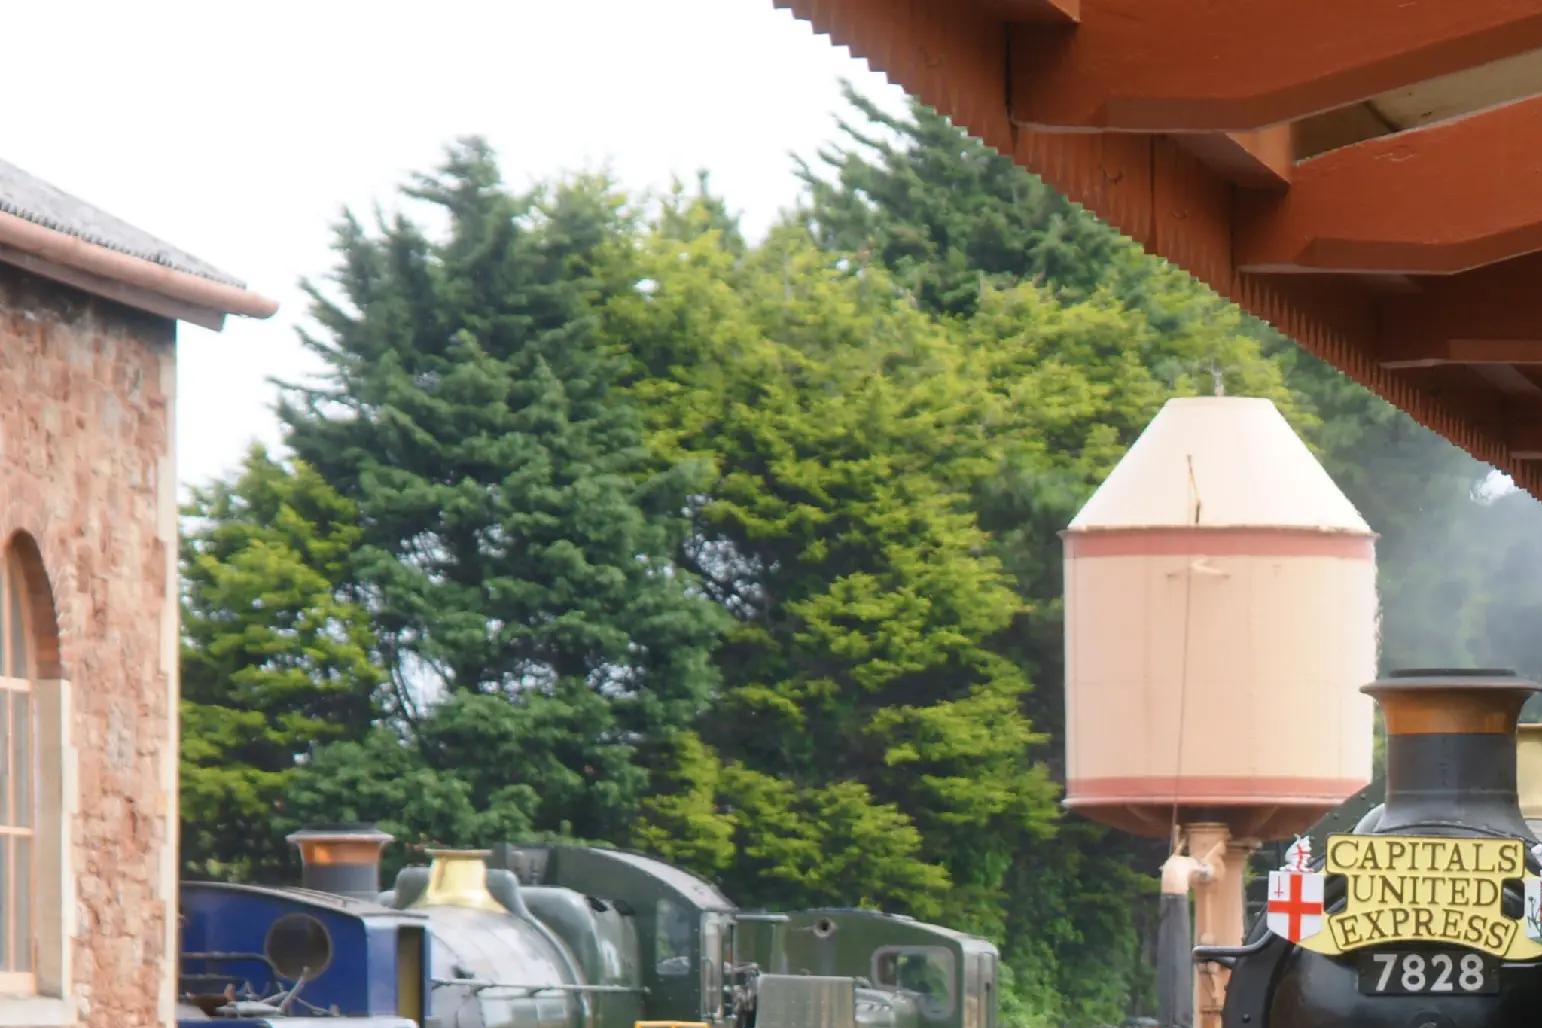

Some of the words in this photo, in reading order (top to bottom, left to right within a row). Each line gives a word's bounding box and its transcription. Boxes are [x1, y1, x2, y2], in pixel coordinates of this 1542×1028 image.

[1330, 839, 1519, 874] CAPITALS
[1352, 874, 1499, 907] UNITED
[1335, 907, 1511, 951] EXPRESS
[1372, 953, 1485, 993] 7828
